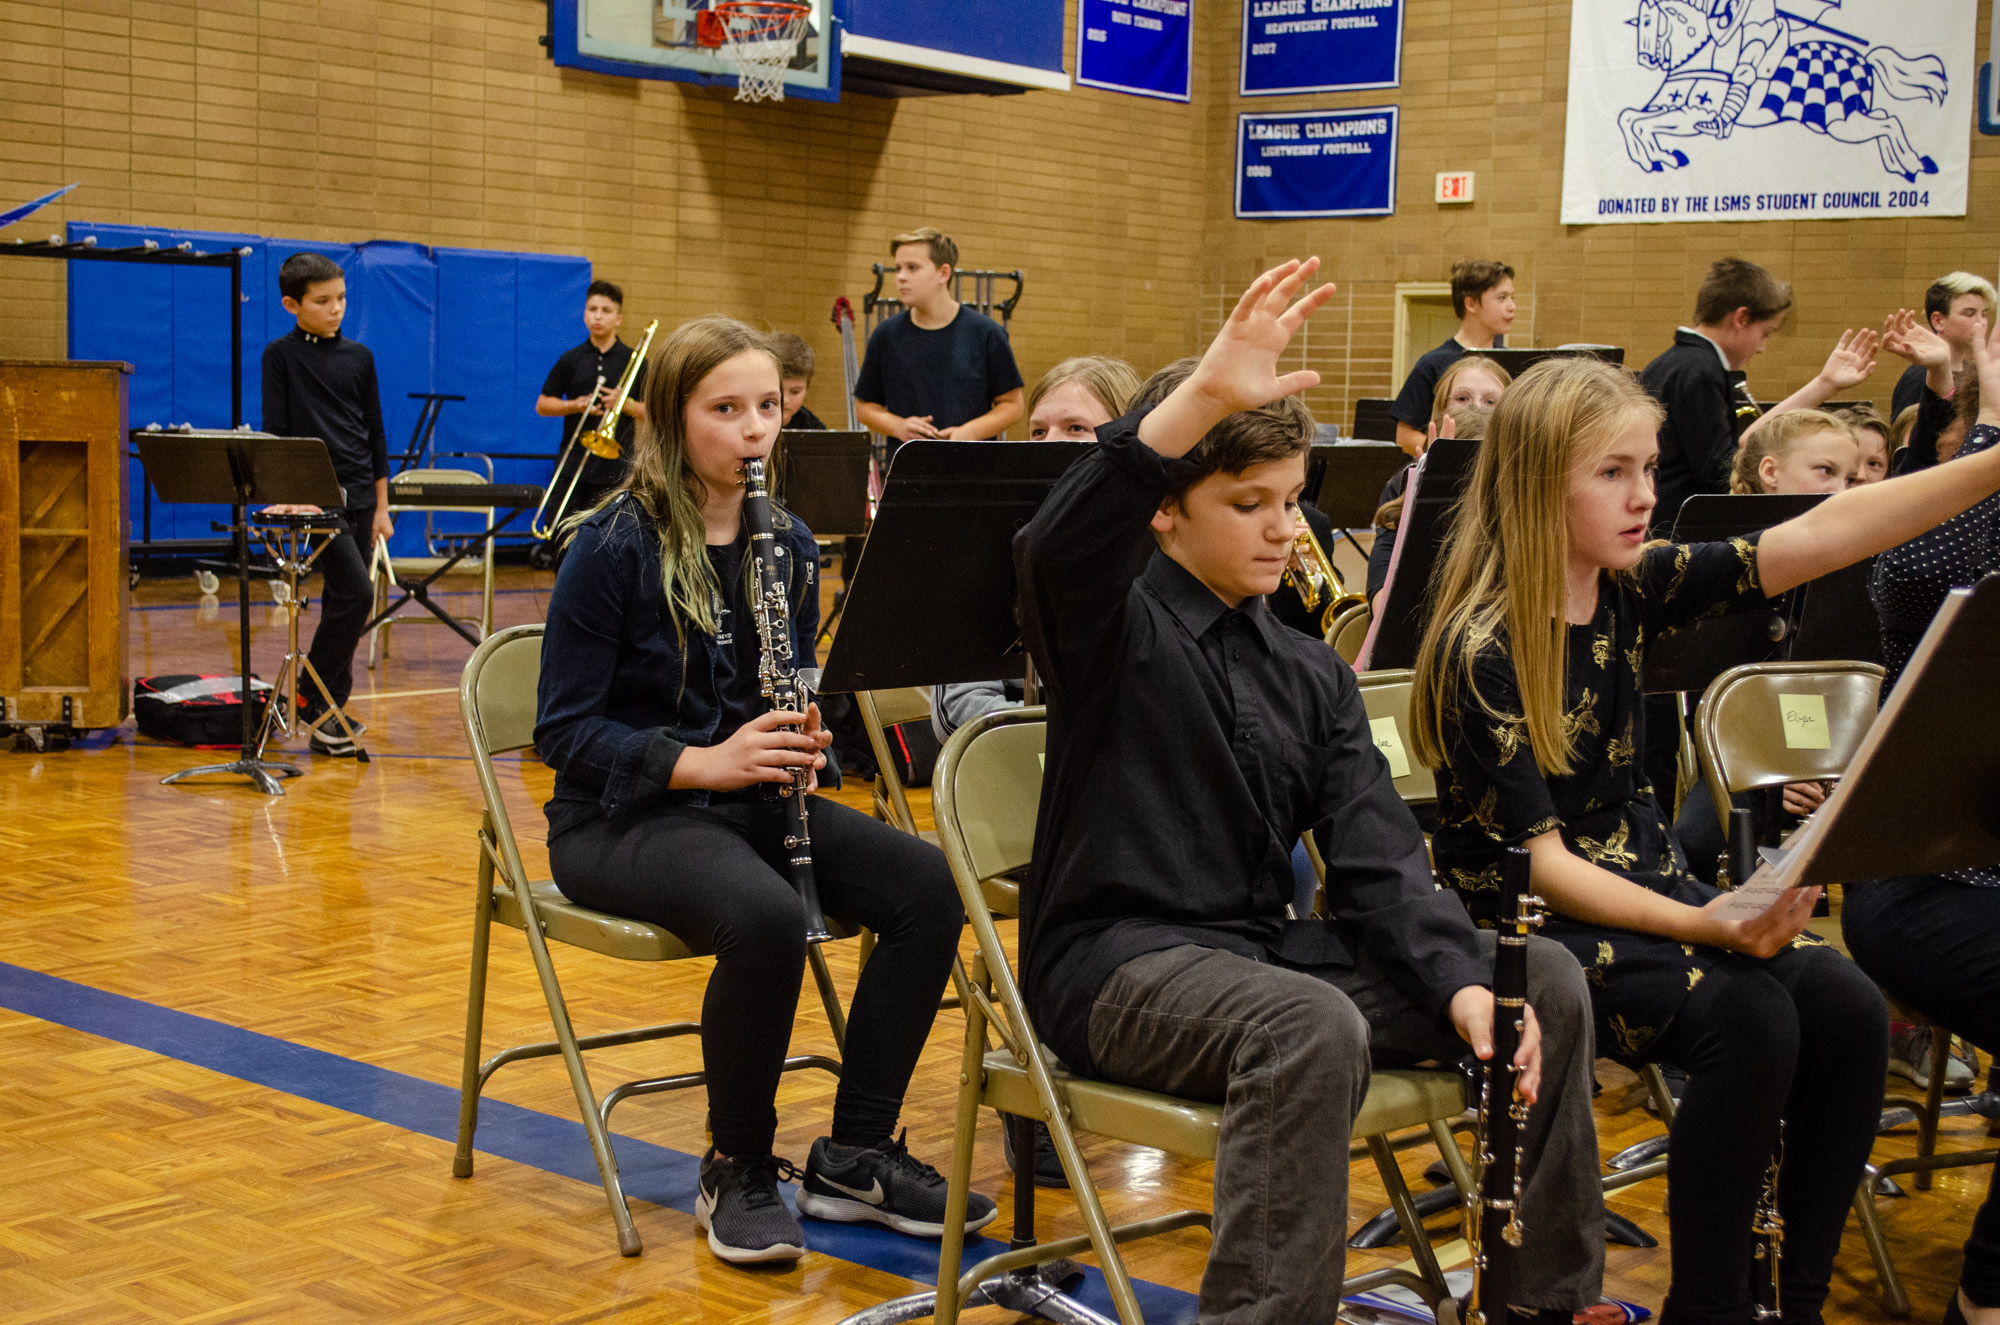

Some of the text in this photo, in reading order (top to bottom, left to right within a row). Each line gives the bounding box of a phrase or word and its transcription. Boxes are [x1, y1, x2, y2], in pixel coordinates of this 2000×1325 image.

[1253, 0, 1306, 17] LEAGUE
[1264, 15, 1378, 35] HEAVYWEIGHT FOOTBALL
[1248, 118, 1387, 141] LEAGUE CHAMPIONS
[1261, 142, 1372, 157] LIGHTWEIGHT FOOTBALL
[1442, 176, 1467, 198] EXIT
[1598, 190, 1930, 215] DONATED BY THE LSMS STUDENT COUNCIL 2004
